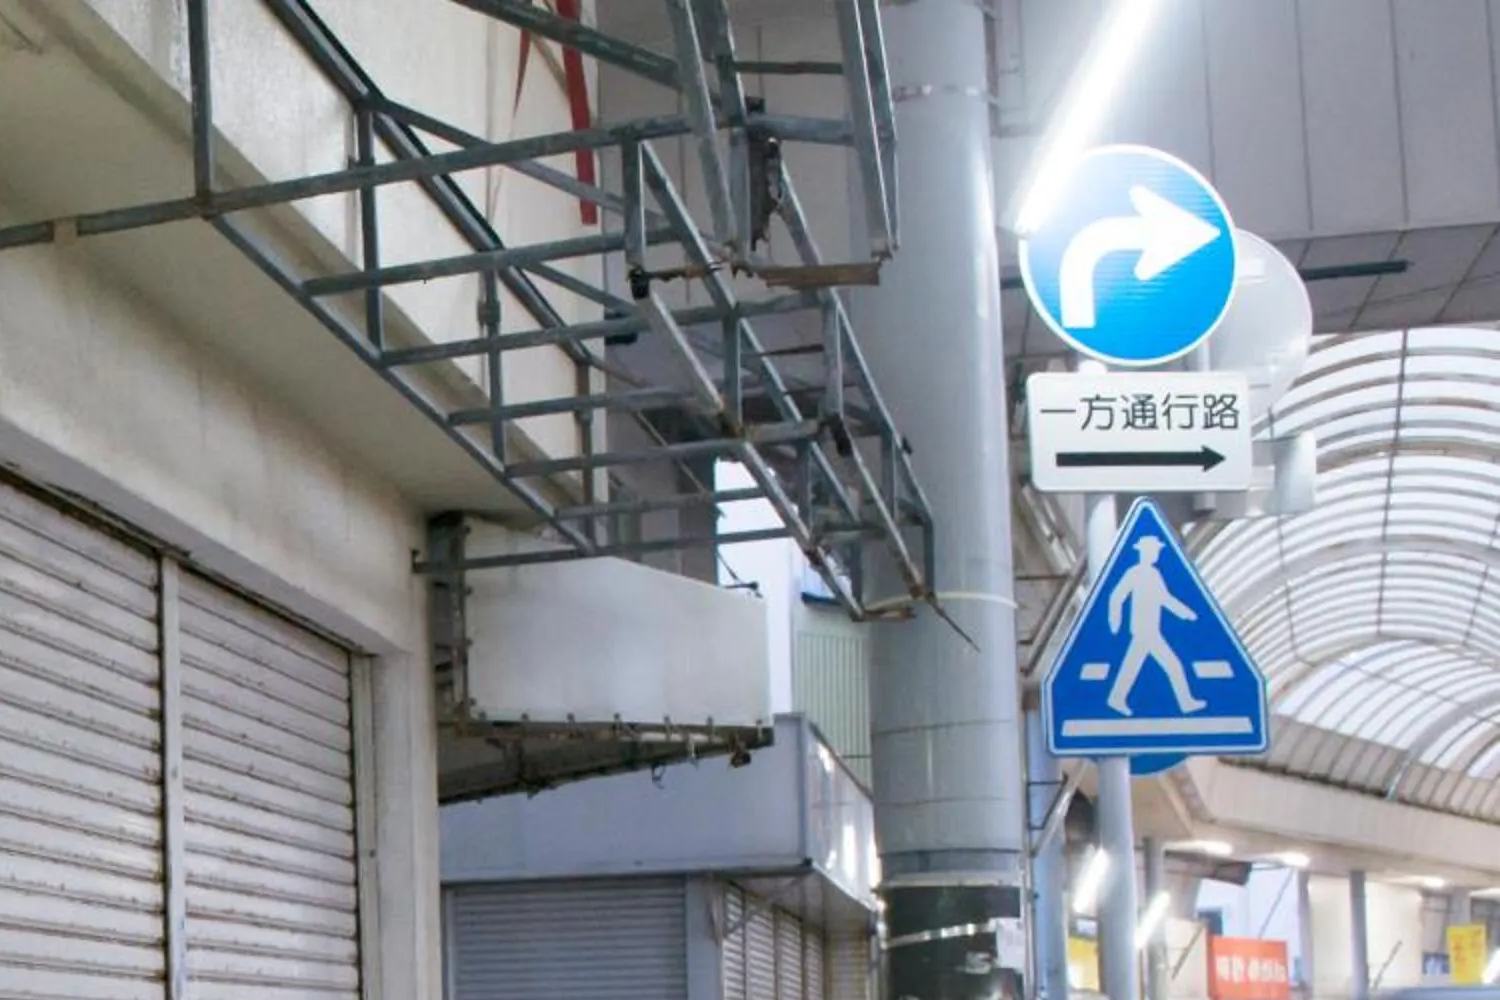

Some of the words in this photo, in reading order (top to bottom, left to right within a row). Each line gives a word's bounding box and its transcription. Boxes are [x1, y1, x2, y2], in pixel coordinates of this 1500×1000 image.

[1040, 393, 1239, 431] 一方通行路
